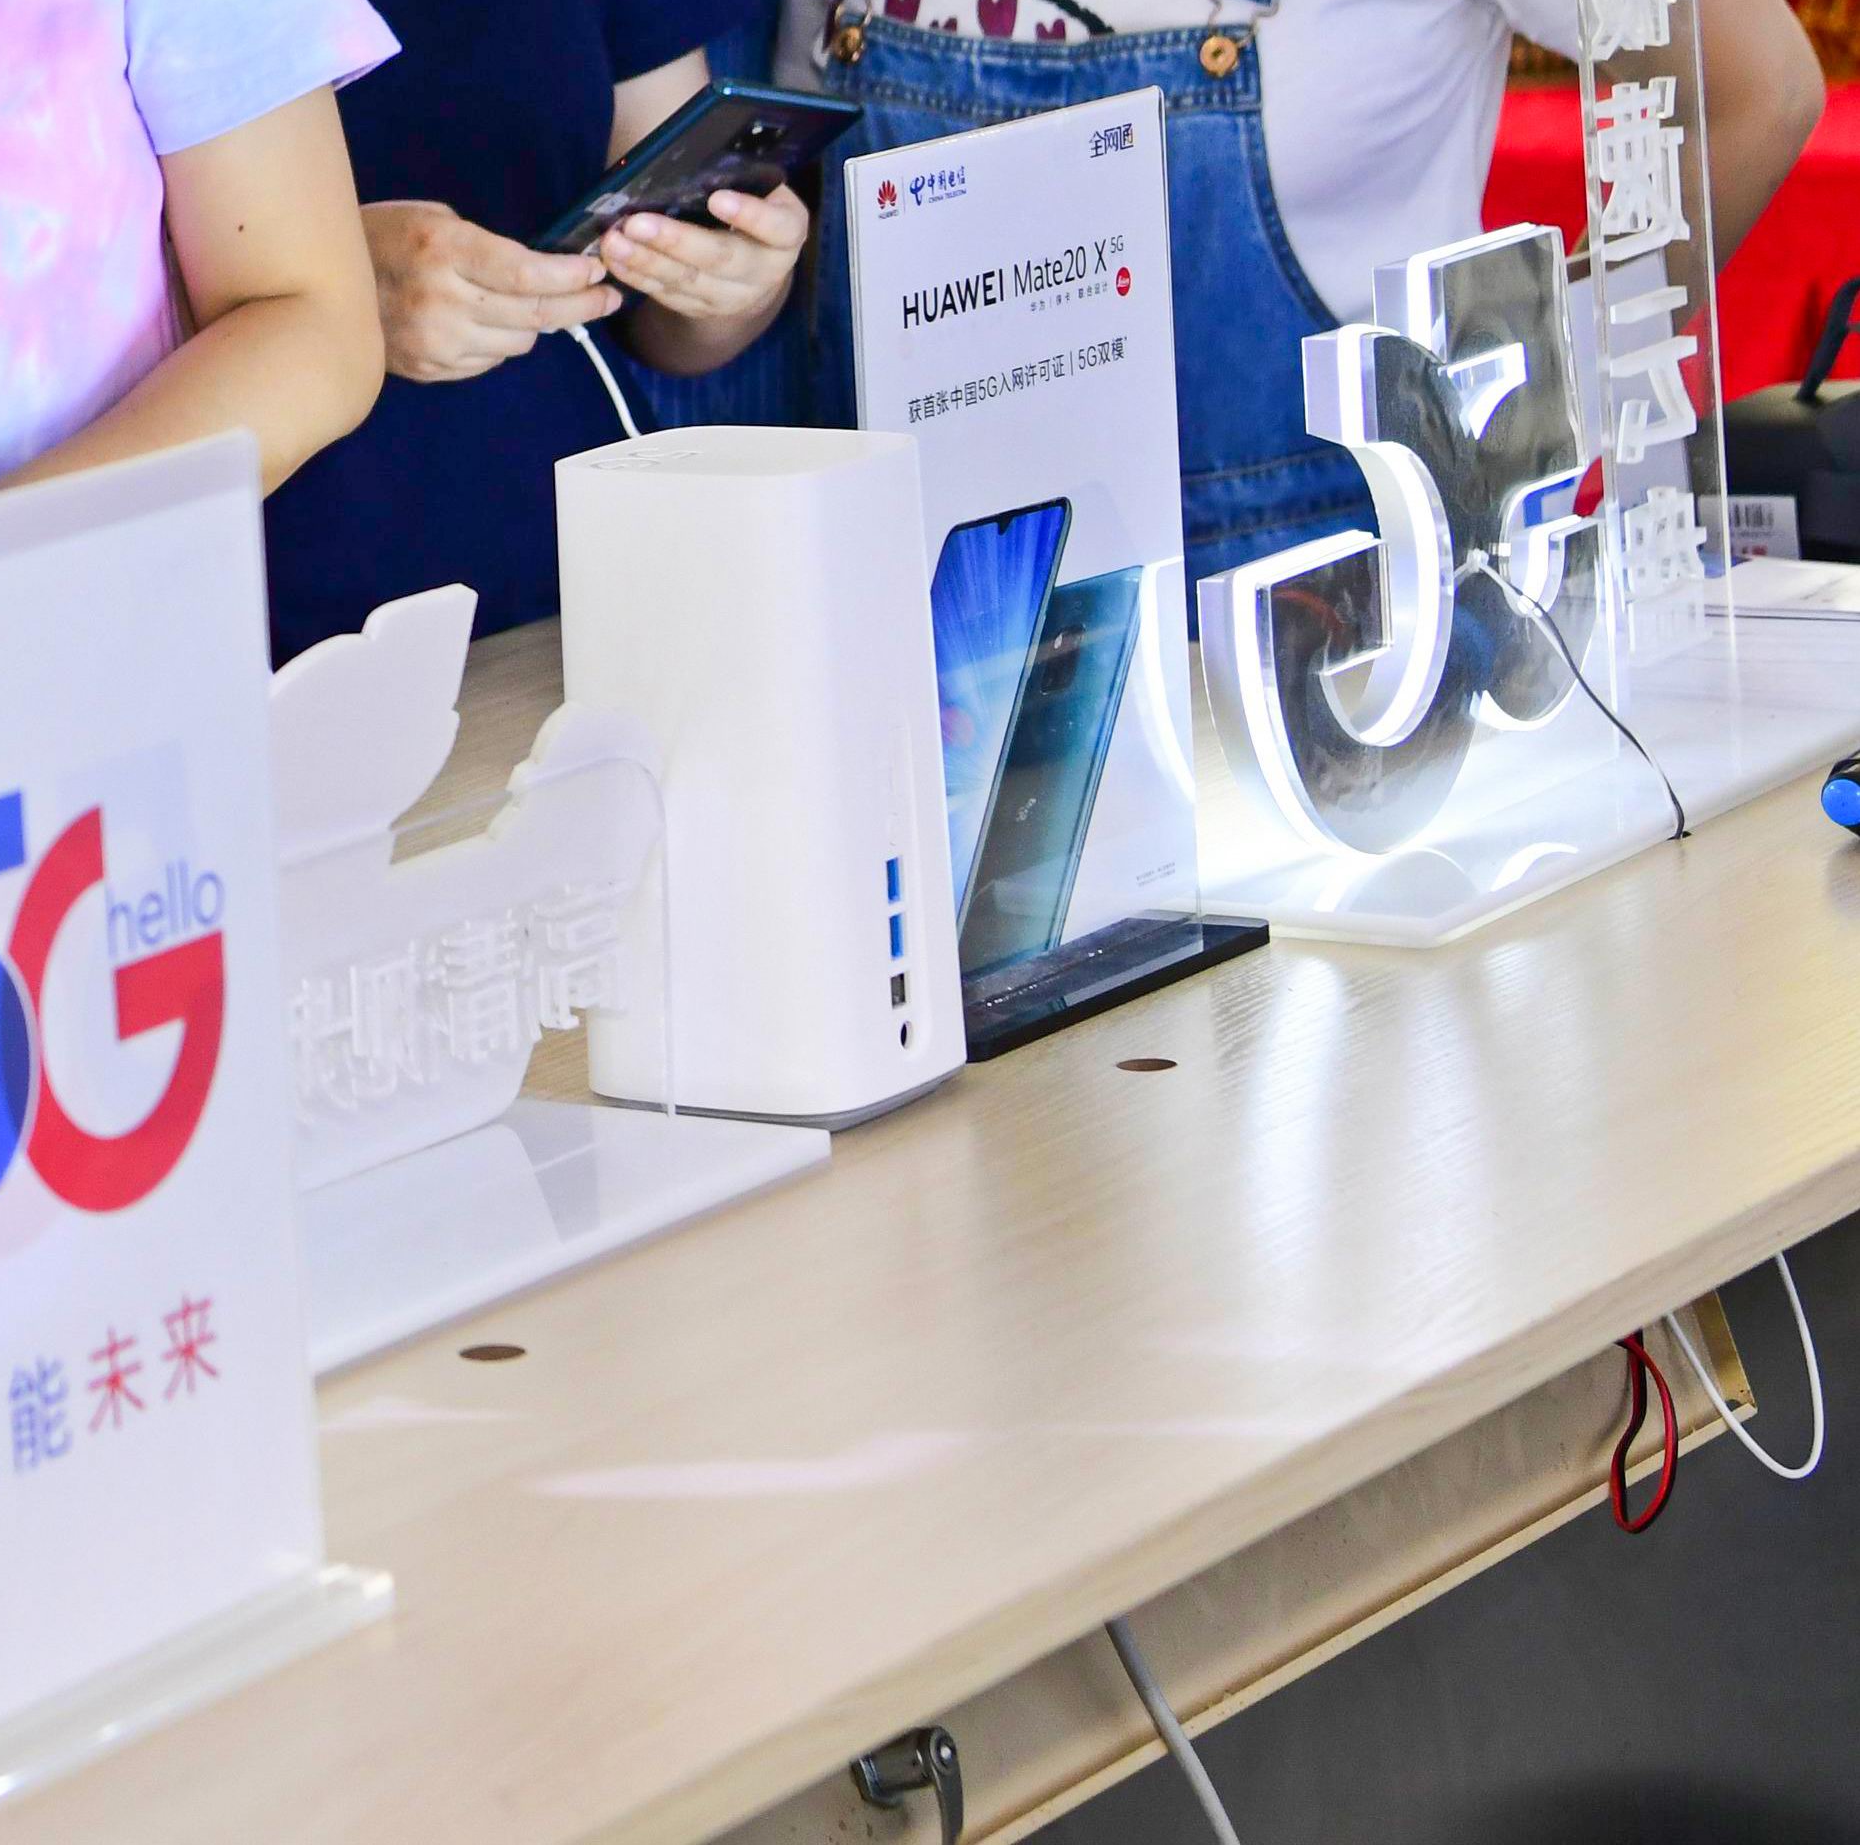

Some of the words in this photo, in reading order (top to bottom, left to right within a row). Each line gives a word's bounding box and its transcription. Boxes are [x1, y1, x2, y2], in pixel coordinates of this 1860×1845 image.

[1088, 123, 1135, 158] 全网通
[903, 268, 1005, 329] HUAWEI
[1013, 245, 1087, 297] Mate20
[1094, 239, 1107, 274] X
[1110, 234, 1124, 254] 5G
[106, 859, 225, 956] hello
